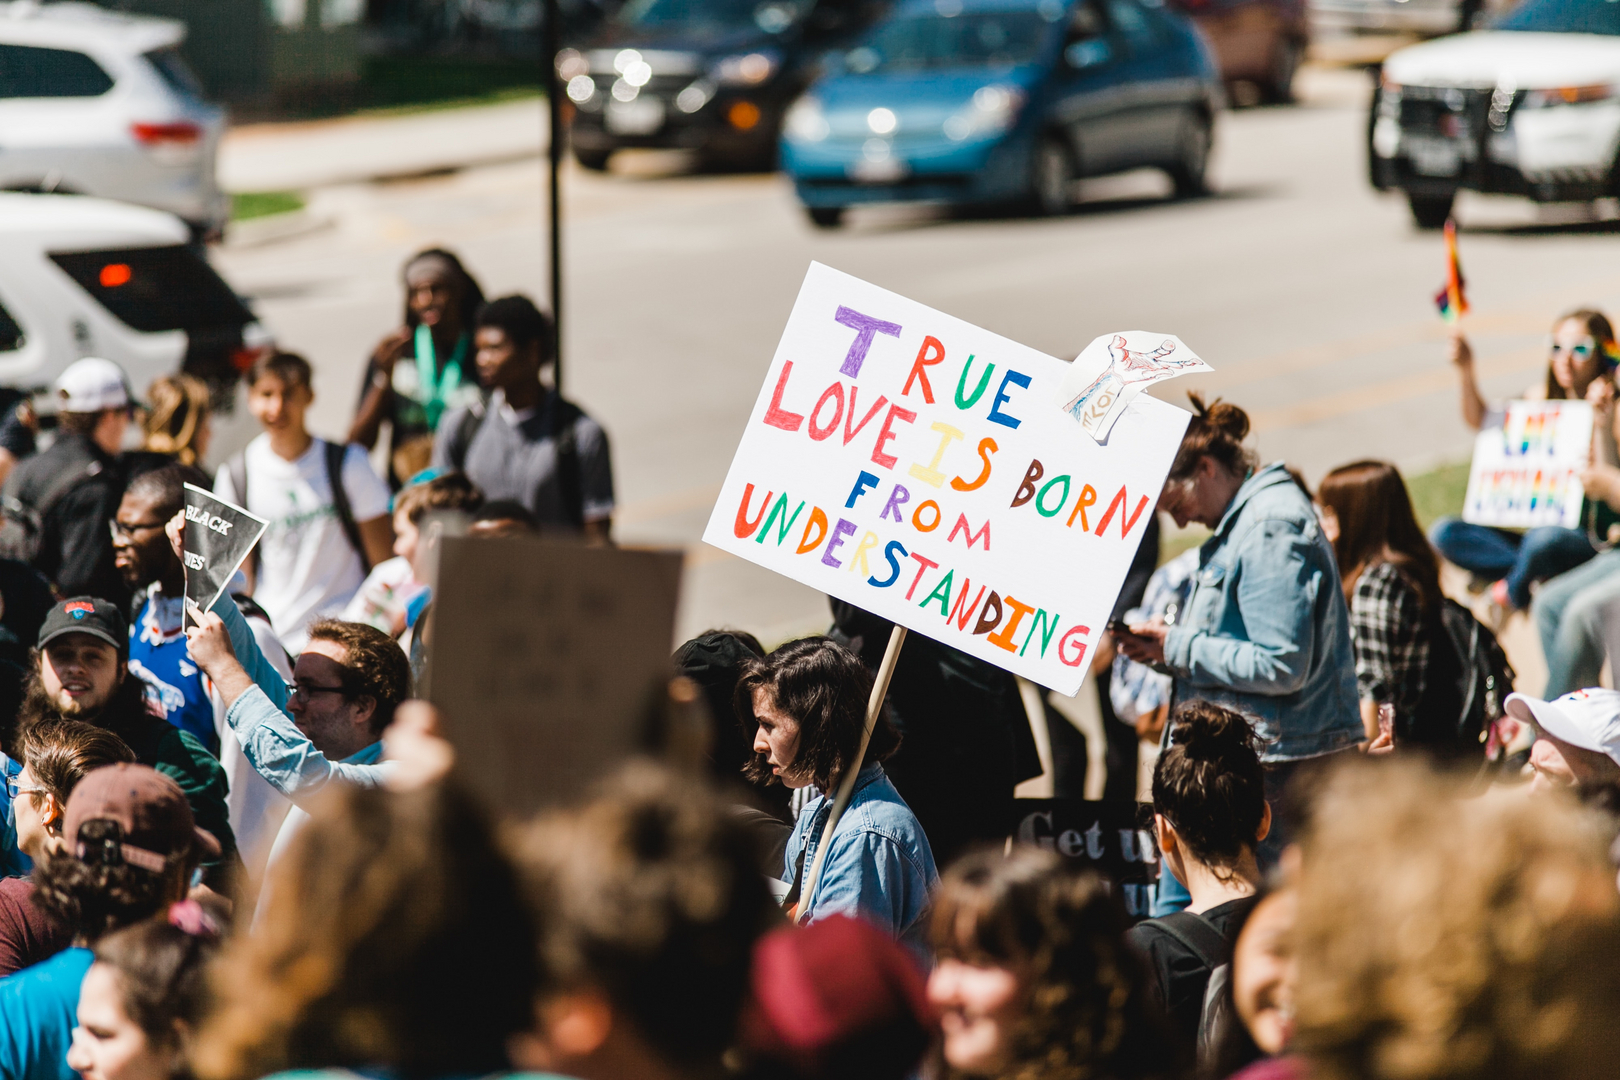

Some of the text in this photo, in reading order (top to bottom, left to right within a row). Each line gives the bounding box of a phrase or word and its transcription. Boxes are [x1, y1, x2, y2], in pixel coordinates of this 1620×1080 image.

[834, 304, 1033, 430] TRUE
[763, 360, 1150, 541] LOVE IS BORN
[184, 504, 233, 537] BLACK
[844, 470, 991, 551] FROM
[733, 482, 1091, 668] UNDERSTANDING
[1018, 811, 1105, 861] Get
